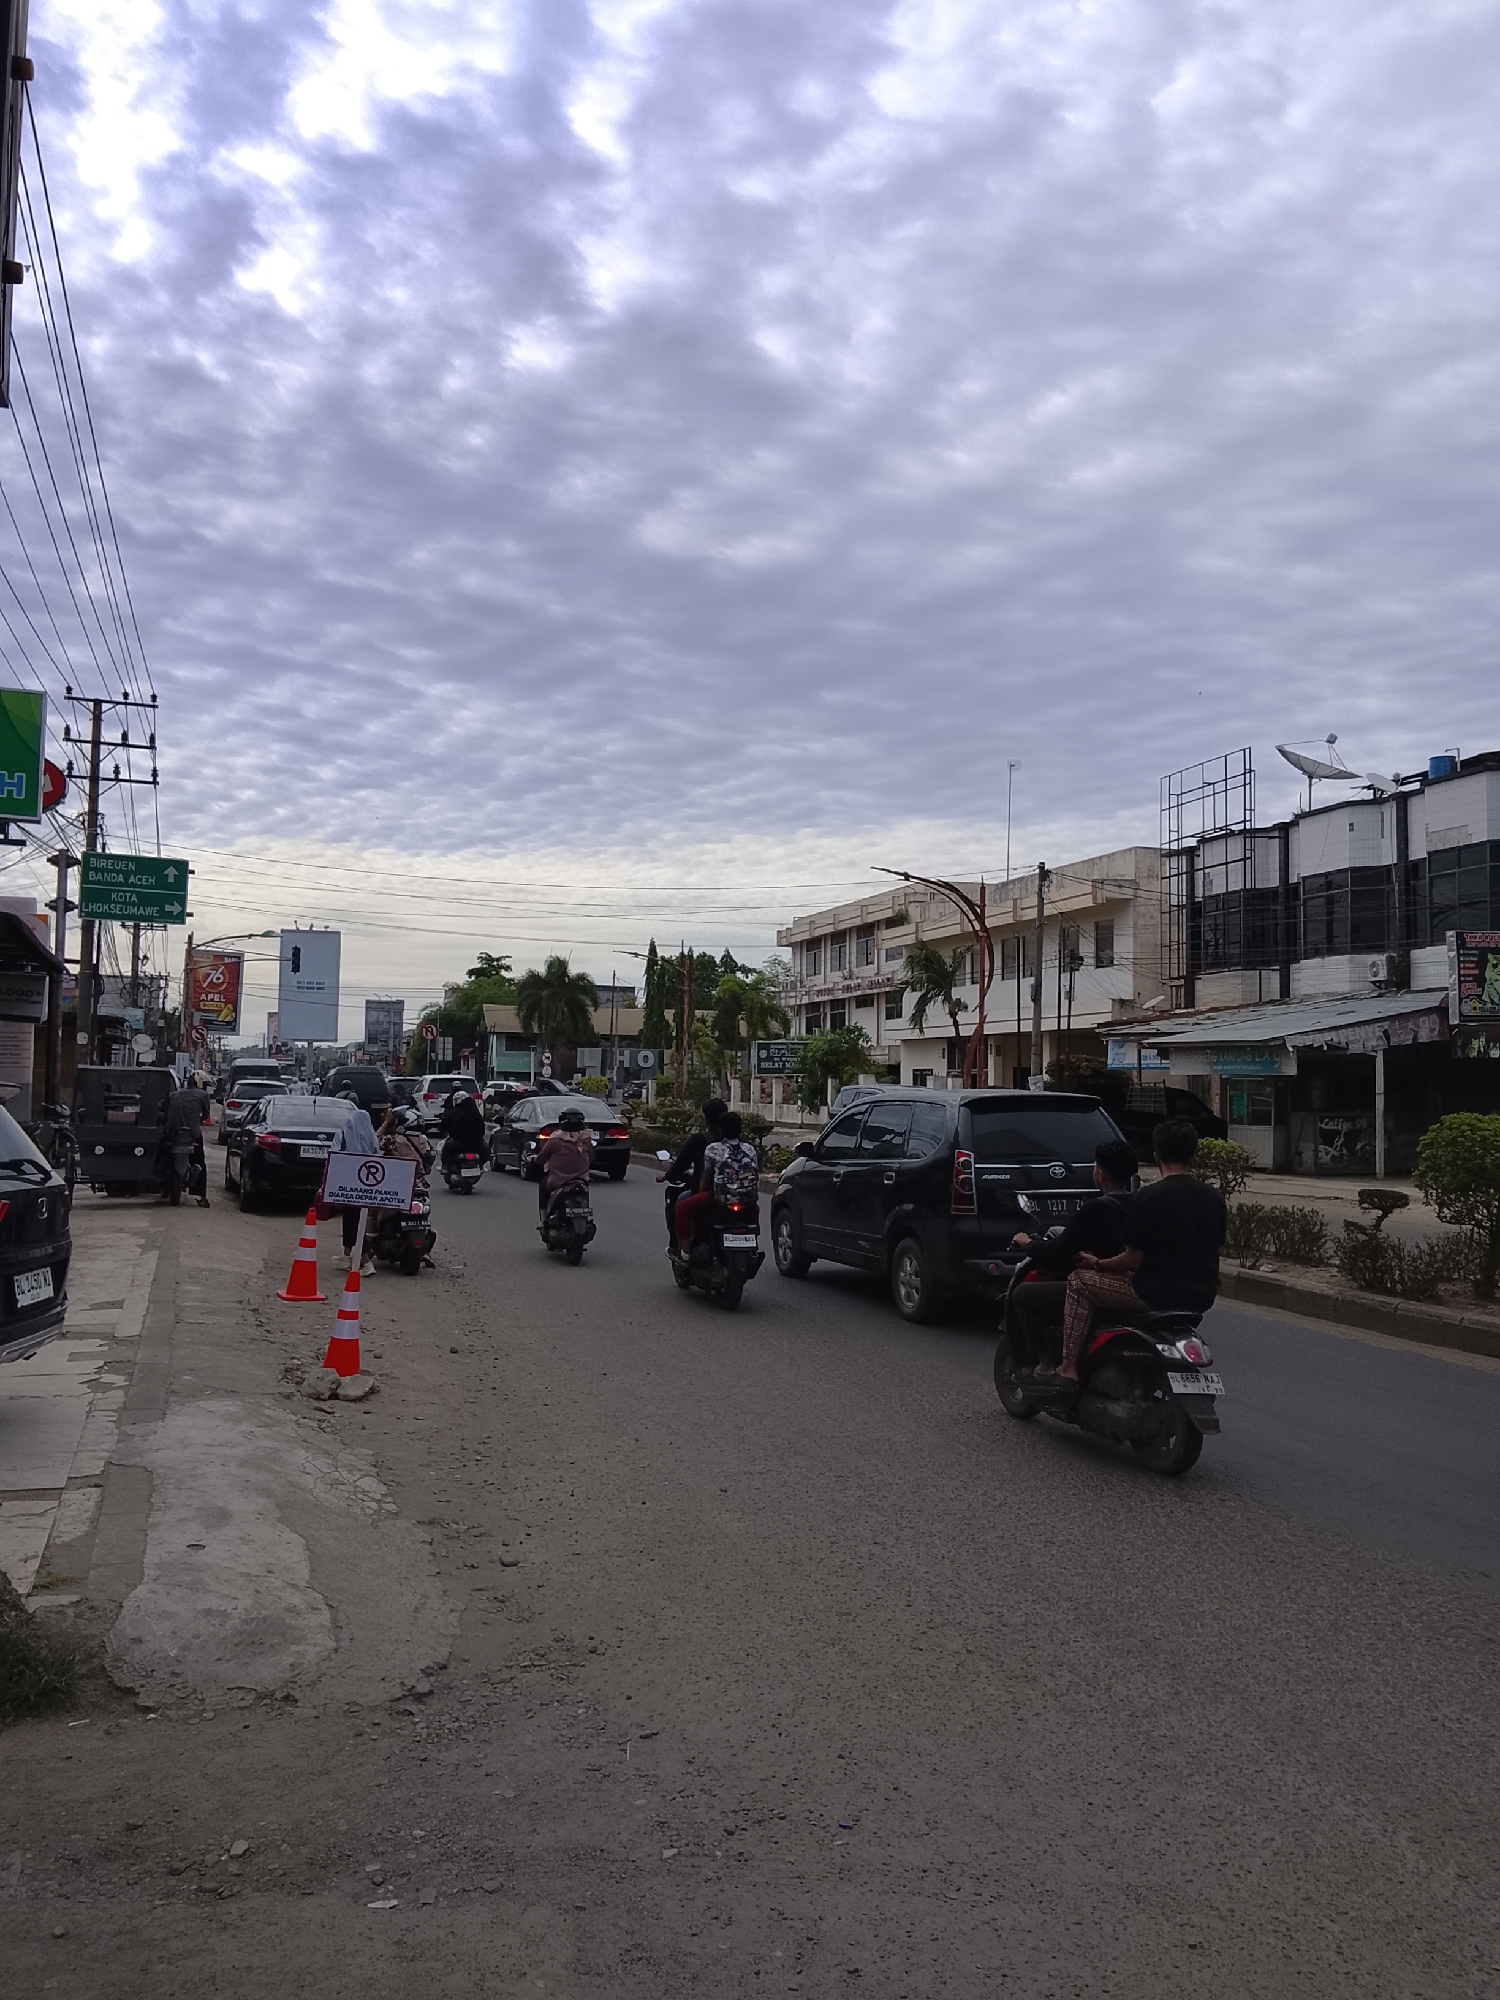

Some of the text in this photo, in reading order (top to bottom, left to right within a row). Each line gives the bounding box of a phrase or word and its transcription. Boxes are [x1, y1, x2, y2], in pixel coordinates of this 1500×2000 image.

[90, 858, 136, 871] BIREUEN
[88, 871, 156, 885] BANDA ACEH
[111, 892, 138, 903] KOTA
[82, 902, 160, 916] LHOKSEUMAWE
[204, 965, 225, 988] 76
[200, 993, 226, 1001] APEL
[338, 1185, 399, 1197] DILARANG PARKIR
[328, 1192, 354, 1200] DIAREA
[355, 1194, 377, 1202] DEPAN
[379, 1196, 406, 1204] APOTEK
[15, 1277, 26, 1296] BL
[1169, 1373, 1181, 1383] BL
